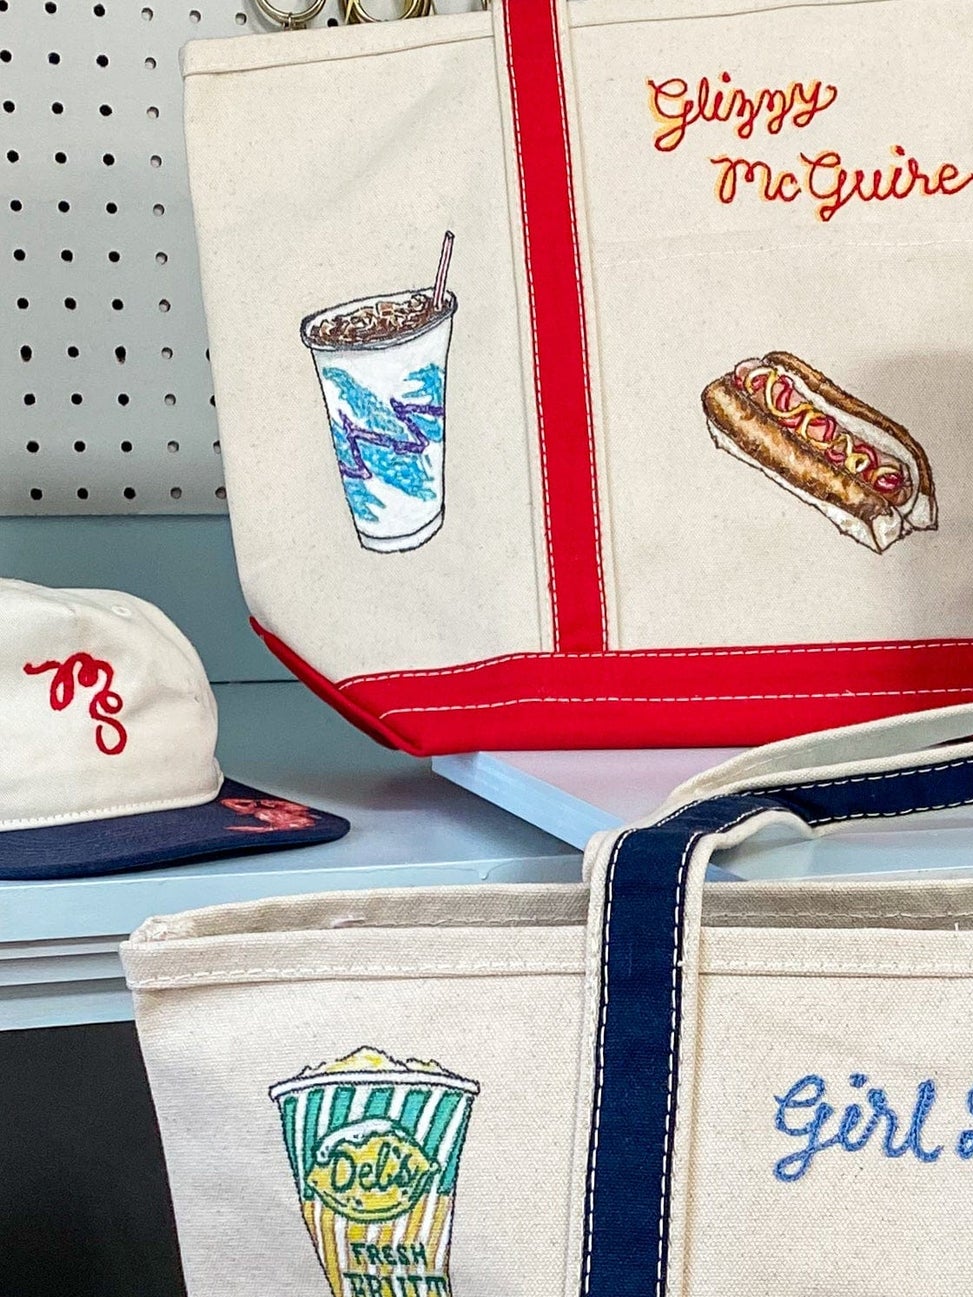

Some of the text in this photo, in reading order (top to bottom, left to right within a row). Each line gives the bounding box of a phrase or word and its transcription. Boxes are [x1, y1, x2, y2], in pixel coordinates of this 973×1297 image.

[647, 71, 838, 152] Glizzy
[773, 1072, 943, 1182] Girl
[350, 1242, 428, 1267] FRESH
